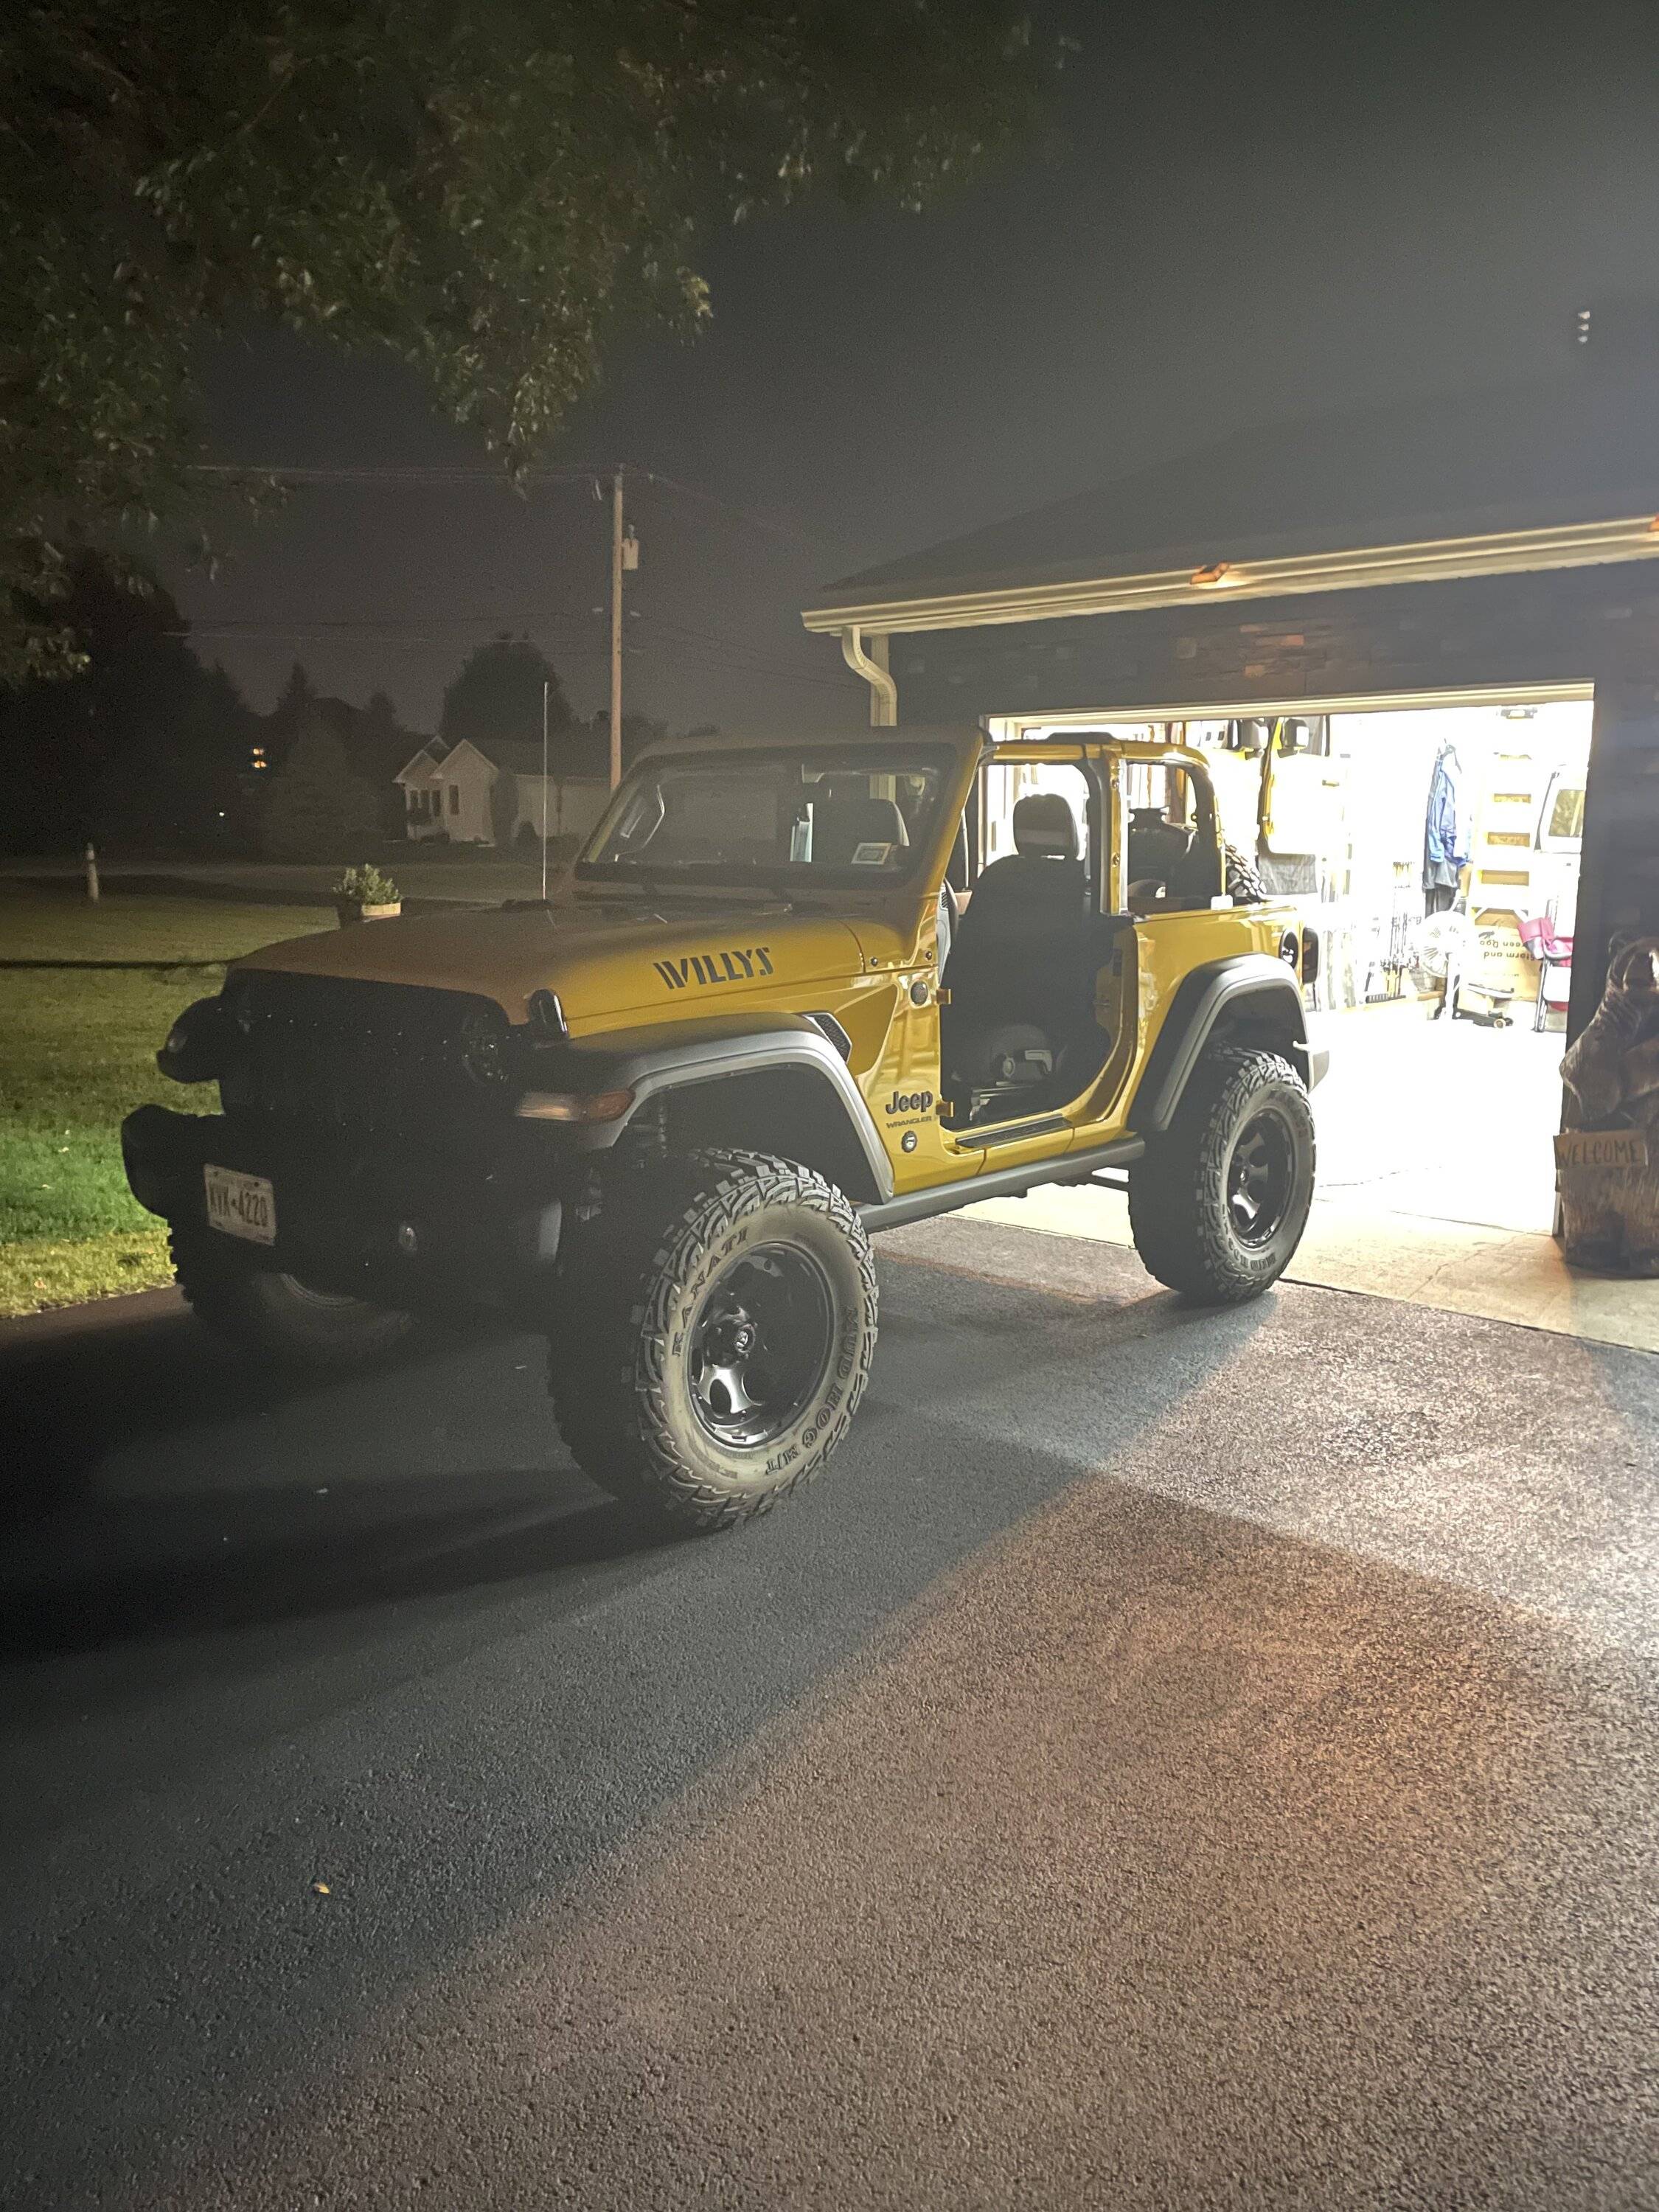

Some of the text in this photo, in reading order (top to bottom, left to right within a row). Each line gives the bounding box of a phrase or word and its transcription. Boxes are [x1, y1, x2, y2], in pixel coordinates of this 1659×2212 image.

[653, 947, 773, 990] WILLYS
[1484, 951, 1503, 959] and
[886, 1091, 933, 1114] Jeep
[1557, 1138, 1641, 1166] WELCOME
[765, 1306, 859, 1475] MUD HOG M/T
